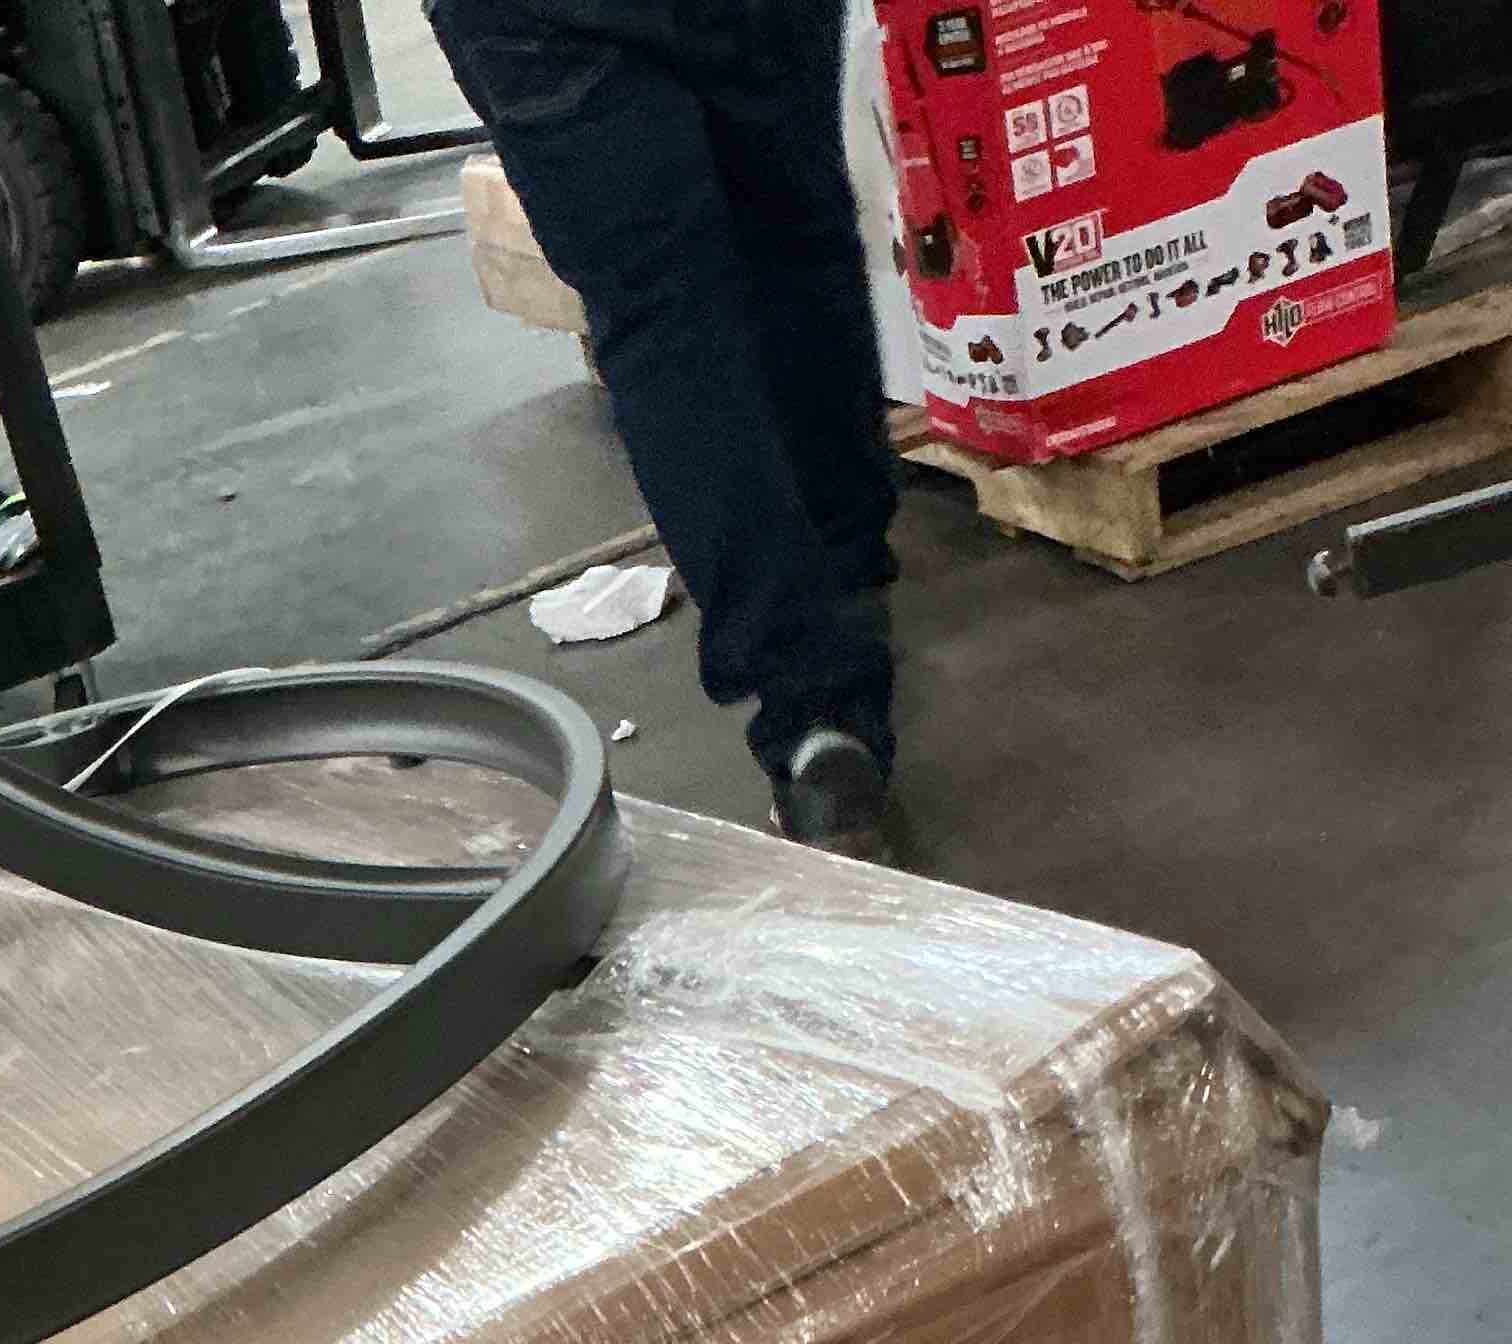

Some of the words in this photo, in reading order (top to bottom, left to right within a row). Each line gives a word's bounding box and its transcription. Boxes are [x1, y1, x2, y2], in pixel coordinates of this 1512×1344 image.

[1041, 279, 1069, 304] THE
[1071, 260, 1121, 295] POWER
[1123, 253, 1142, 277] TO
[1145, 246, 1164, 269] DO
[1167, 239, 1180, 260] IT
[1184, 230, 1208, 256] ALL
